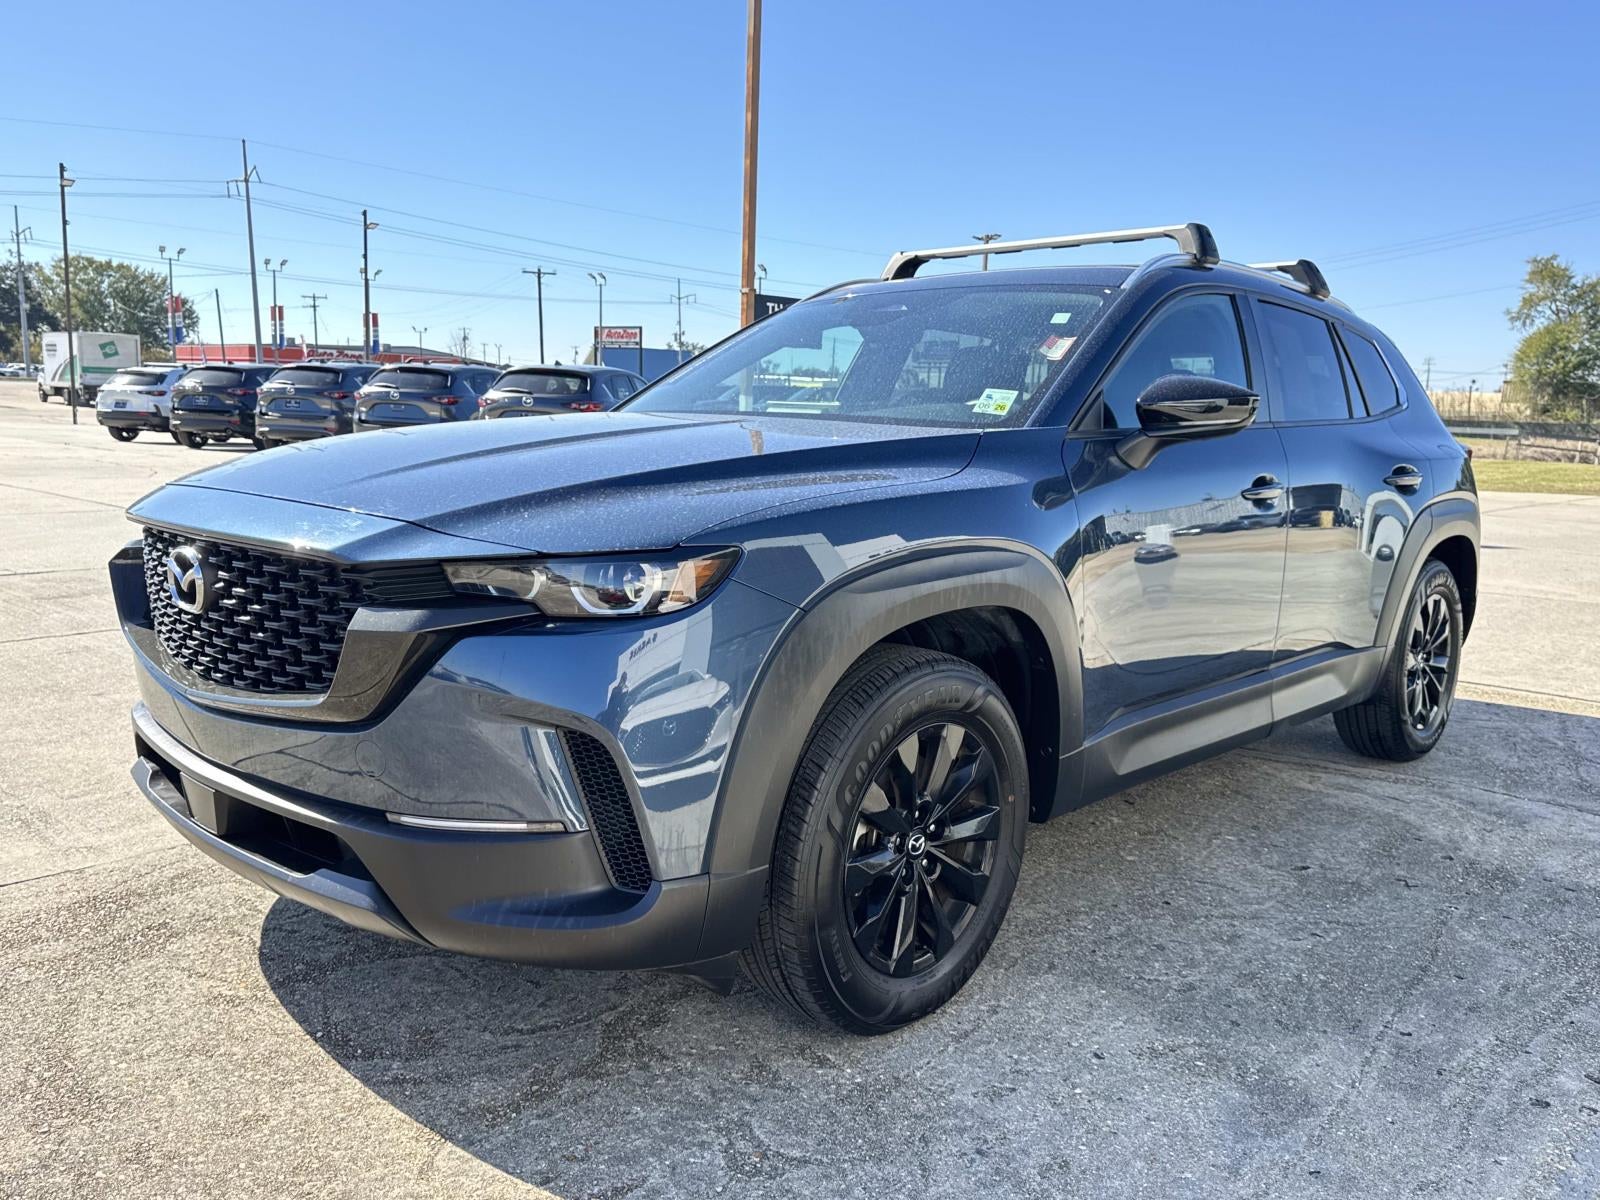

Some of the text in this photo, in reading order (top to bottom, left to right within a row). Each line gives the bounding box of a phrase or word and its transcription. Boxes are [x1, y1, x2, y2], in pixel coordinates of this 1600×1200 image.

[766, 301, 786, 315] TH
[605, 330, 638, 340] AutoZone
[994, 403, 1007, 411] 26
[844, 684, 963, 806] GOODYEAR
